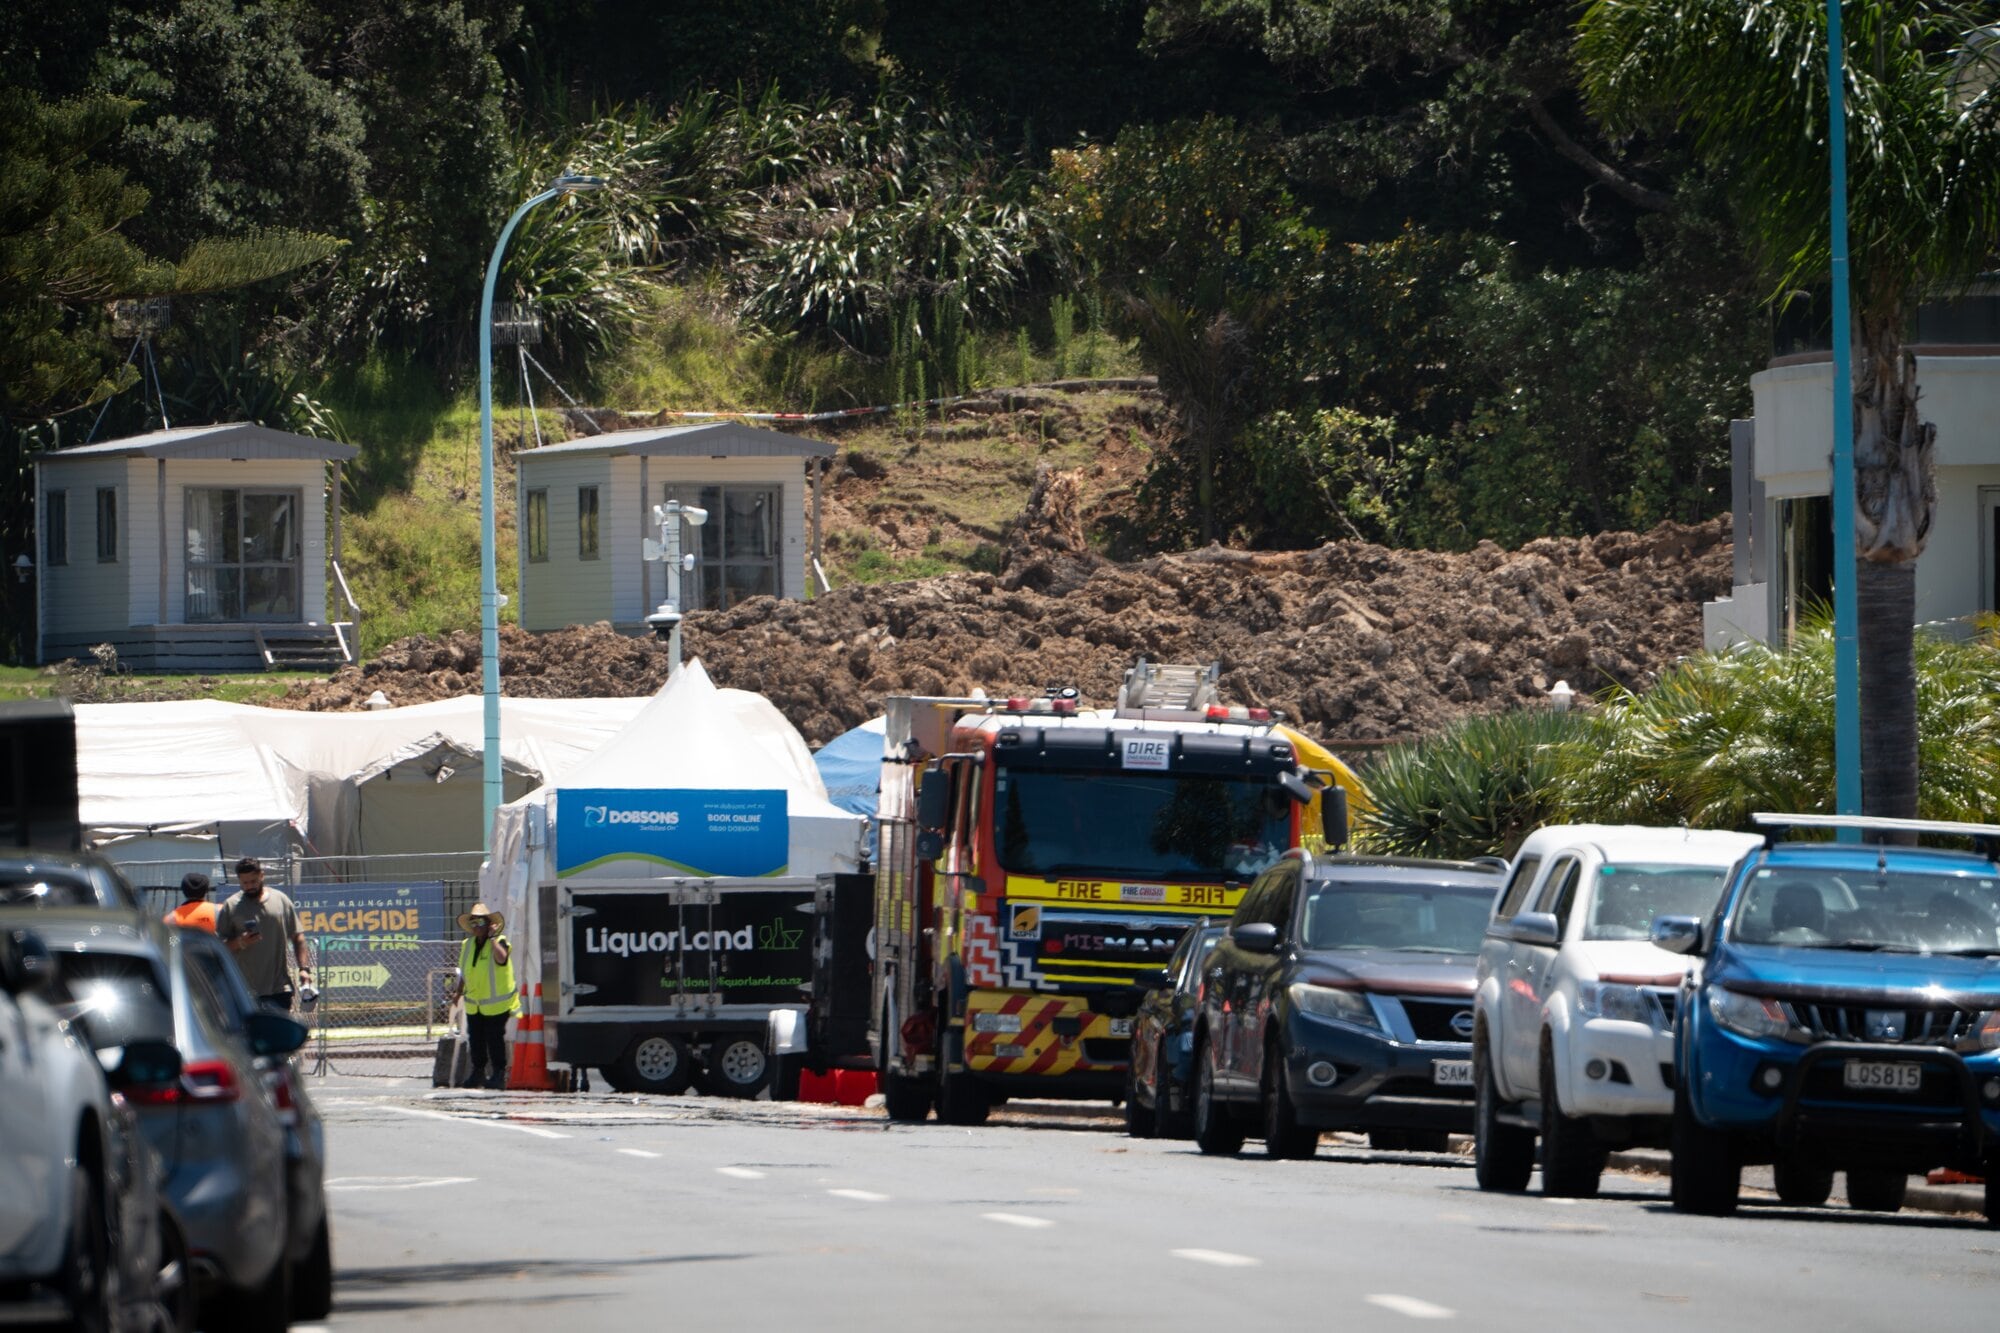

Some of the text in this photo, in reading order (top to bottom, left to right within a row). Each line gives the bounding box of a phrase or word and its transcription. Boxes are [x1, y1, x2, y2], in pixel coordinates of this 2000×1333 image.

[1128, 742, 1166, 755] DIRE
[609, 810, 680, 824] DOBSONS
[707, 813, 762, 823] BOOK ONLINE
[1057, 881, 1103, 898] FIRE
[1122, 885, 1140, 896] FIRE
[294, 899, 418, 909] OUNT MAUNGANUI
[300, 909, 420, 933] EACHSIDE
[368, 933, 421, 951] PARK
[1440, 1065, 1472, 1081] SAM
